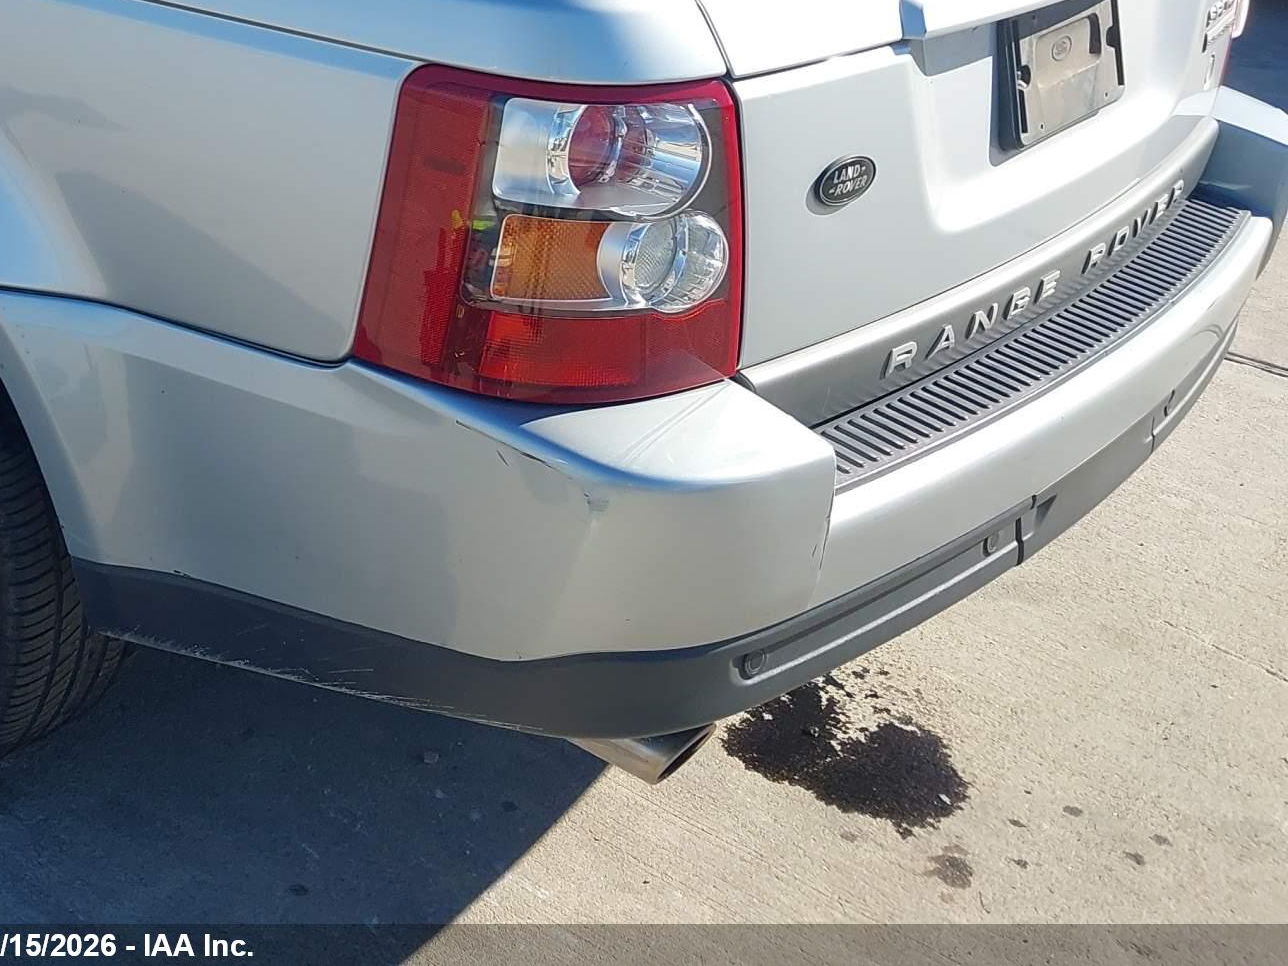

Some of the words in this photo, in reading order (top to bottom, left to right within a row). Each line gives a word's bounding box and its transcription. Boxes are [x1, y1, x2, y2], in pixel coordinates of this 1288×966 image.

[833, 164, 861, 184] LAND
[834, 175, 868, 196] ROVER
[880, 270, 1061, 380] RANGE
[1081, 179, 1185, 274] ROVER
